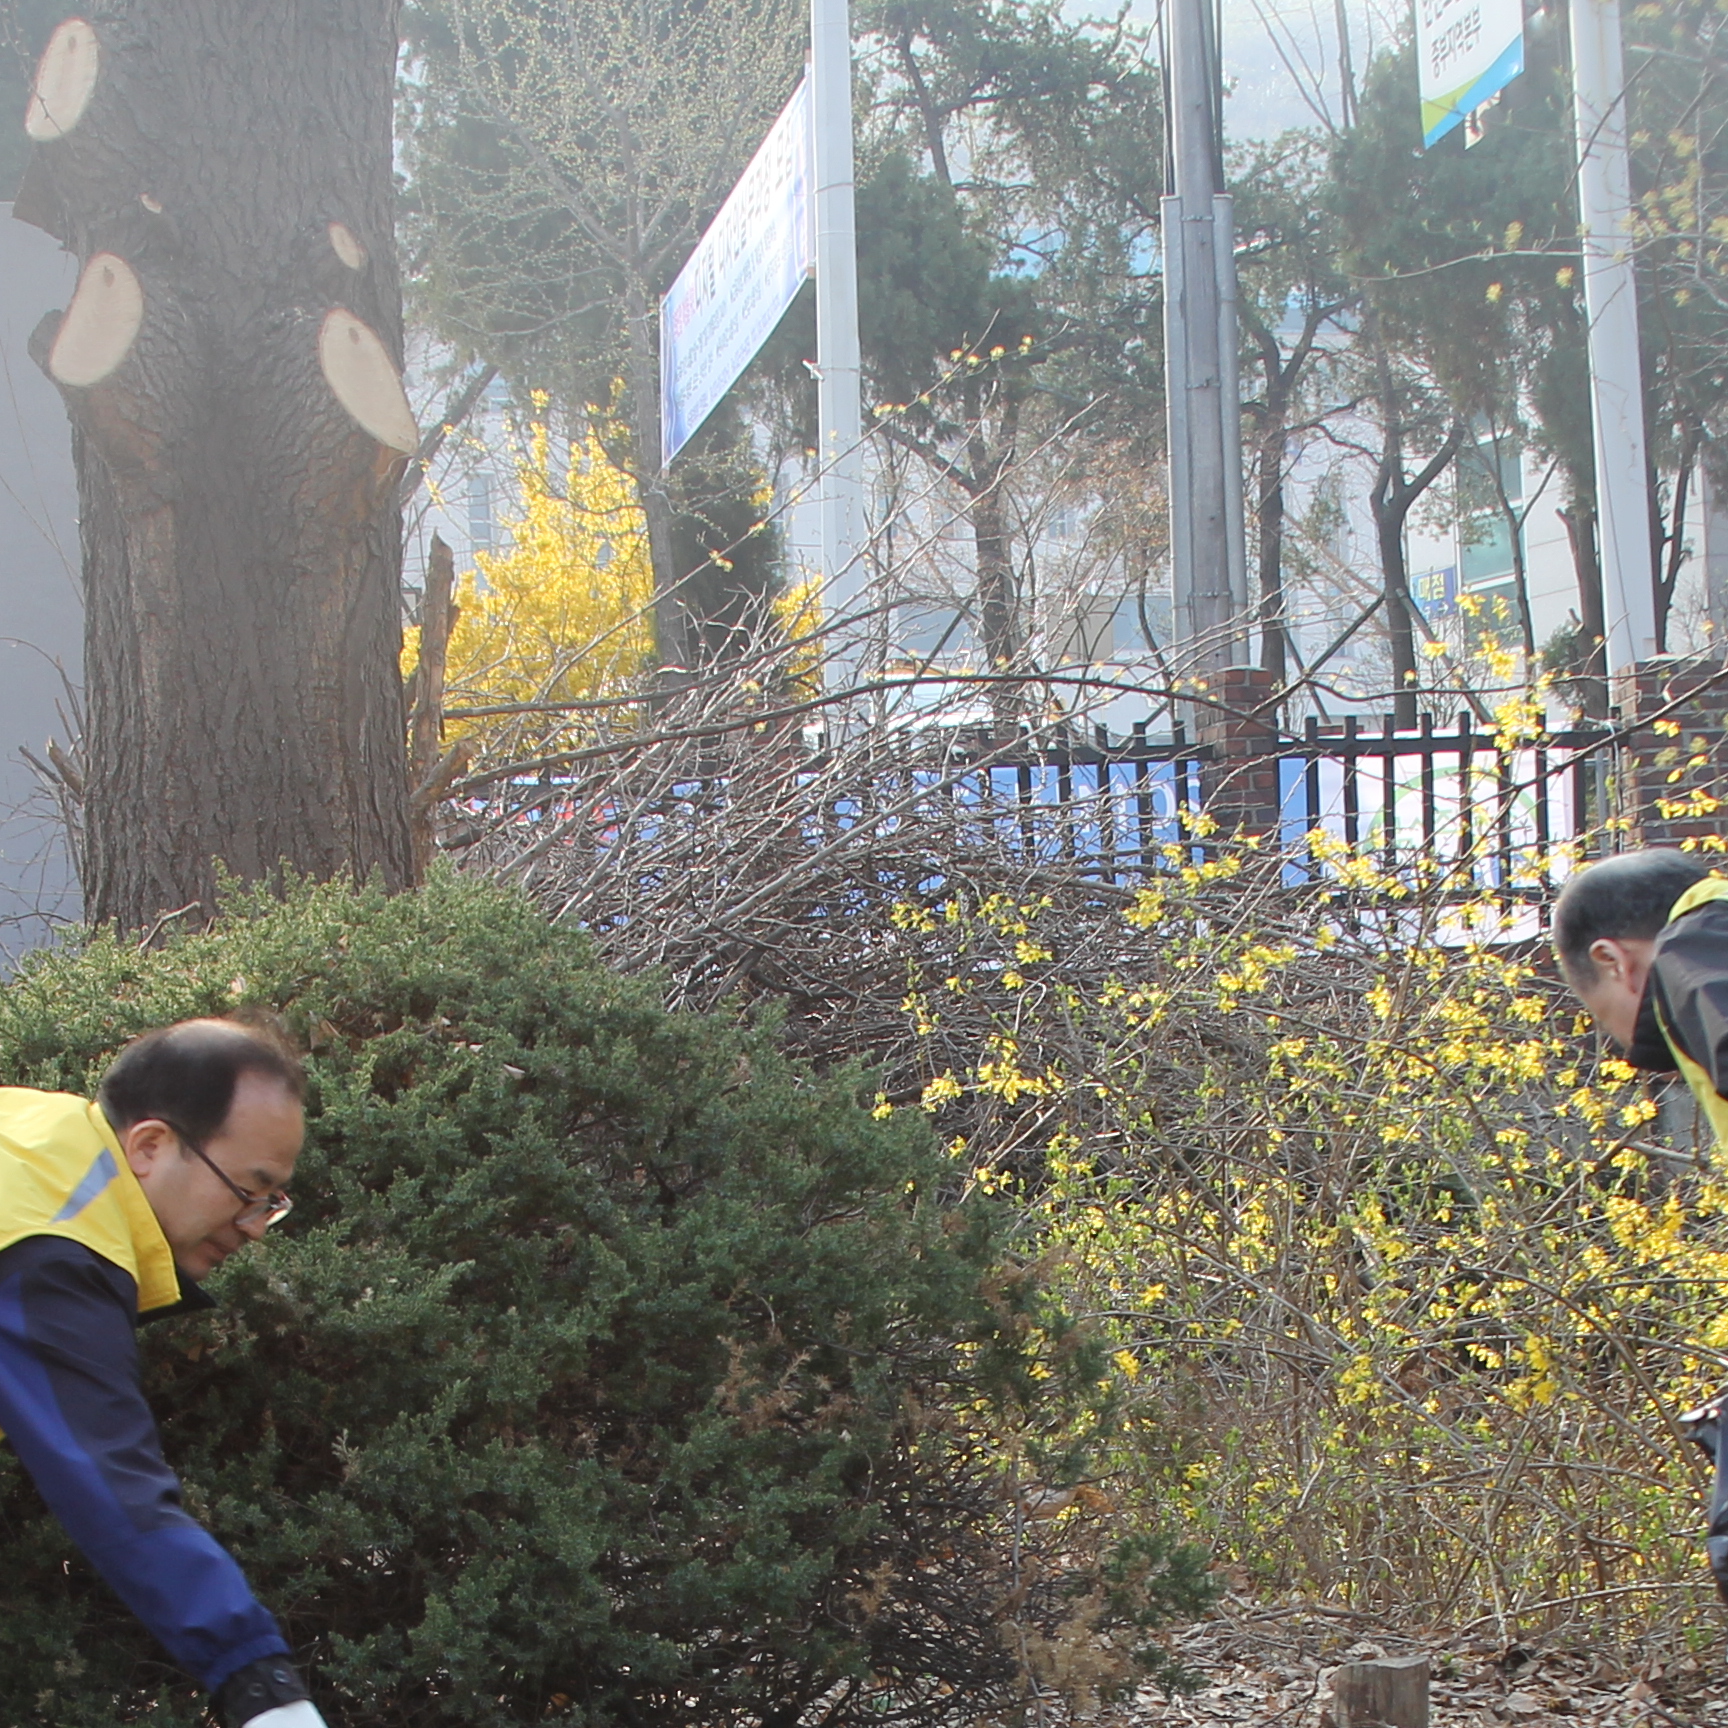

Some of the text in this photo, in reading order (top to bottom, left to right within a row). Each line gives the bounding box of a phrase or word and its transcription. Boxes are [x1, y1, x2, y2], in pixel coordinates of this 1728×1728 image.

[1432, 4, 1481, 79] 중부지역본부
[775, 112, 792, 190] 모집
[1418, 573, 1444, 602] 매점
